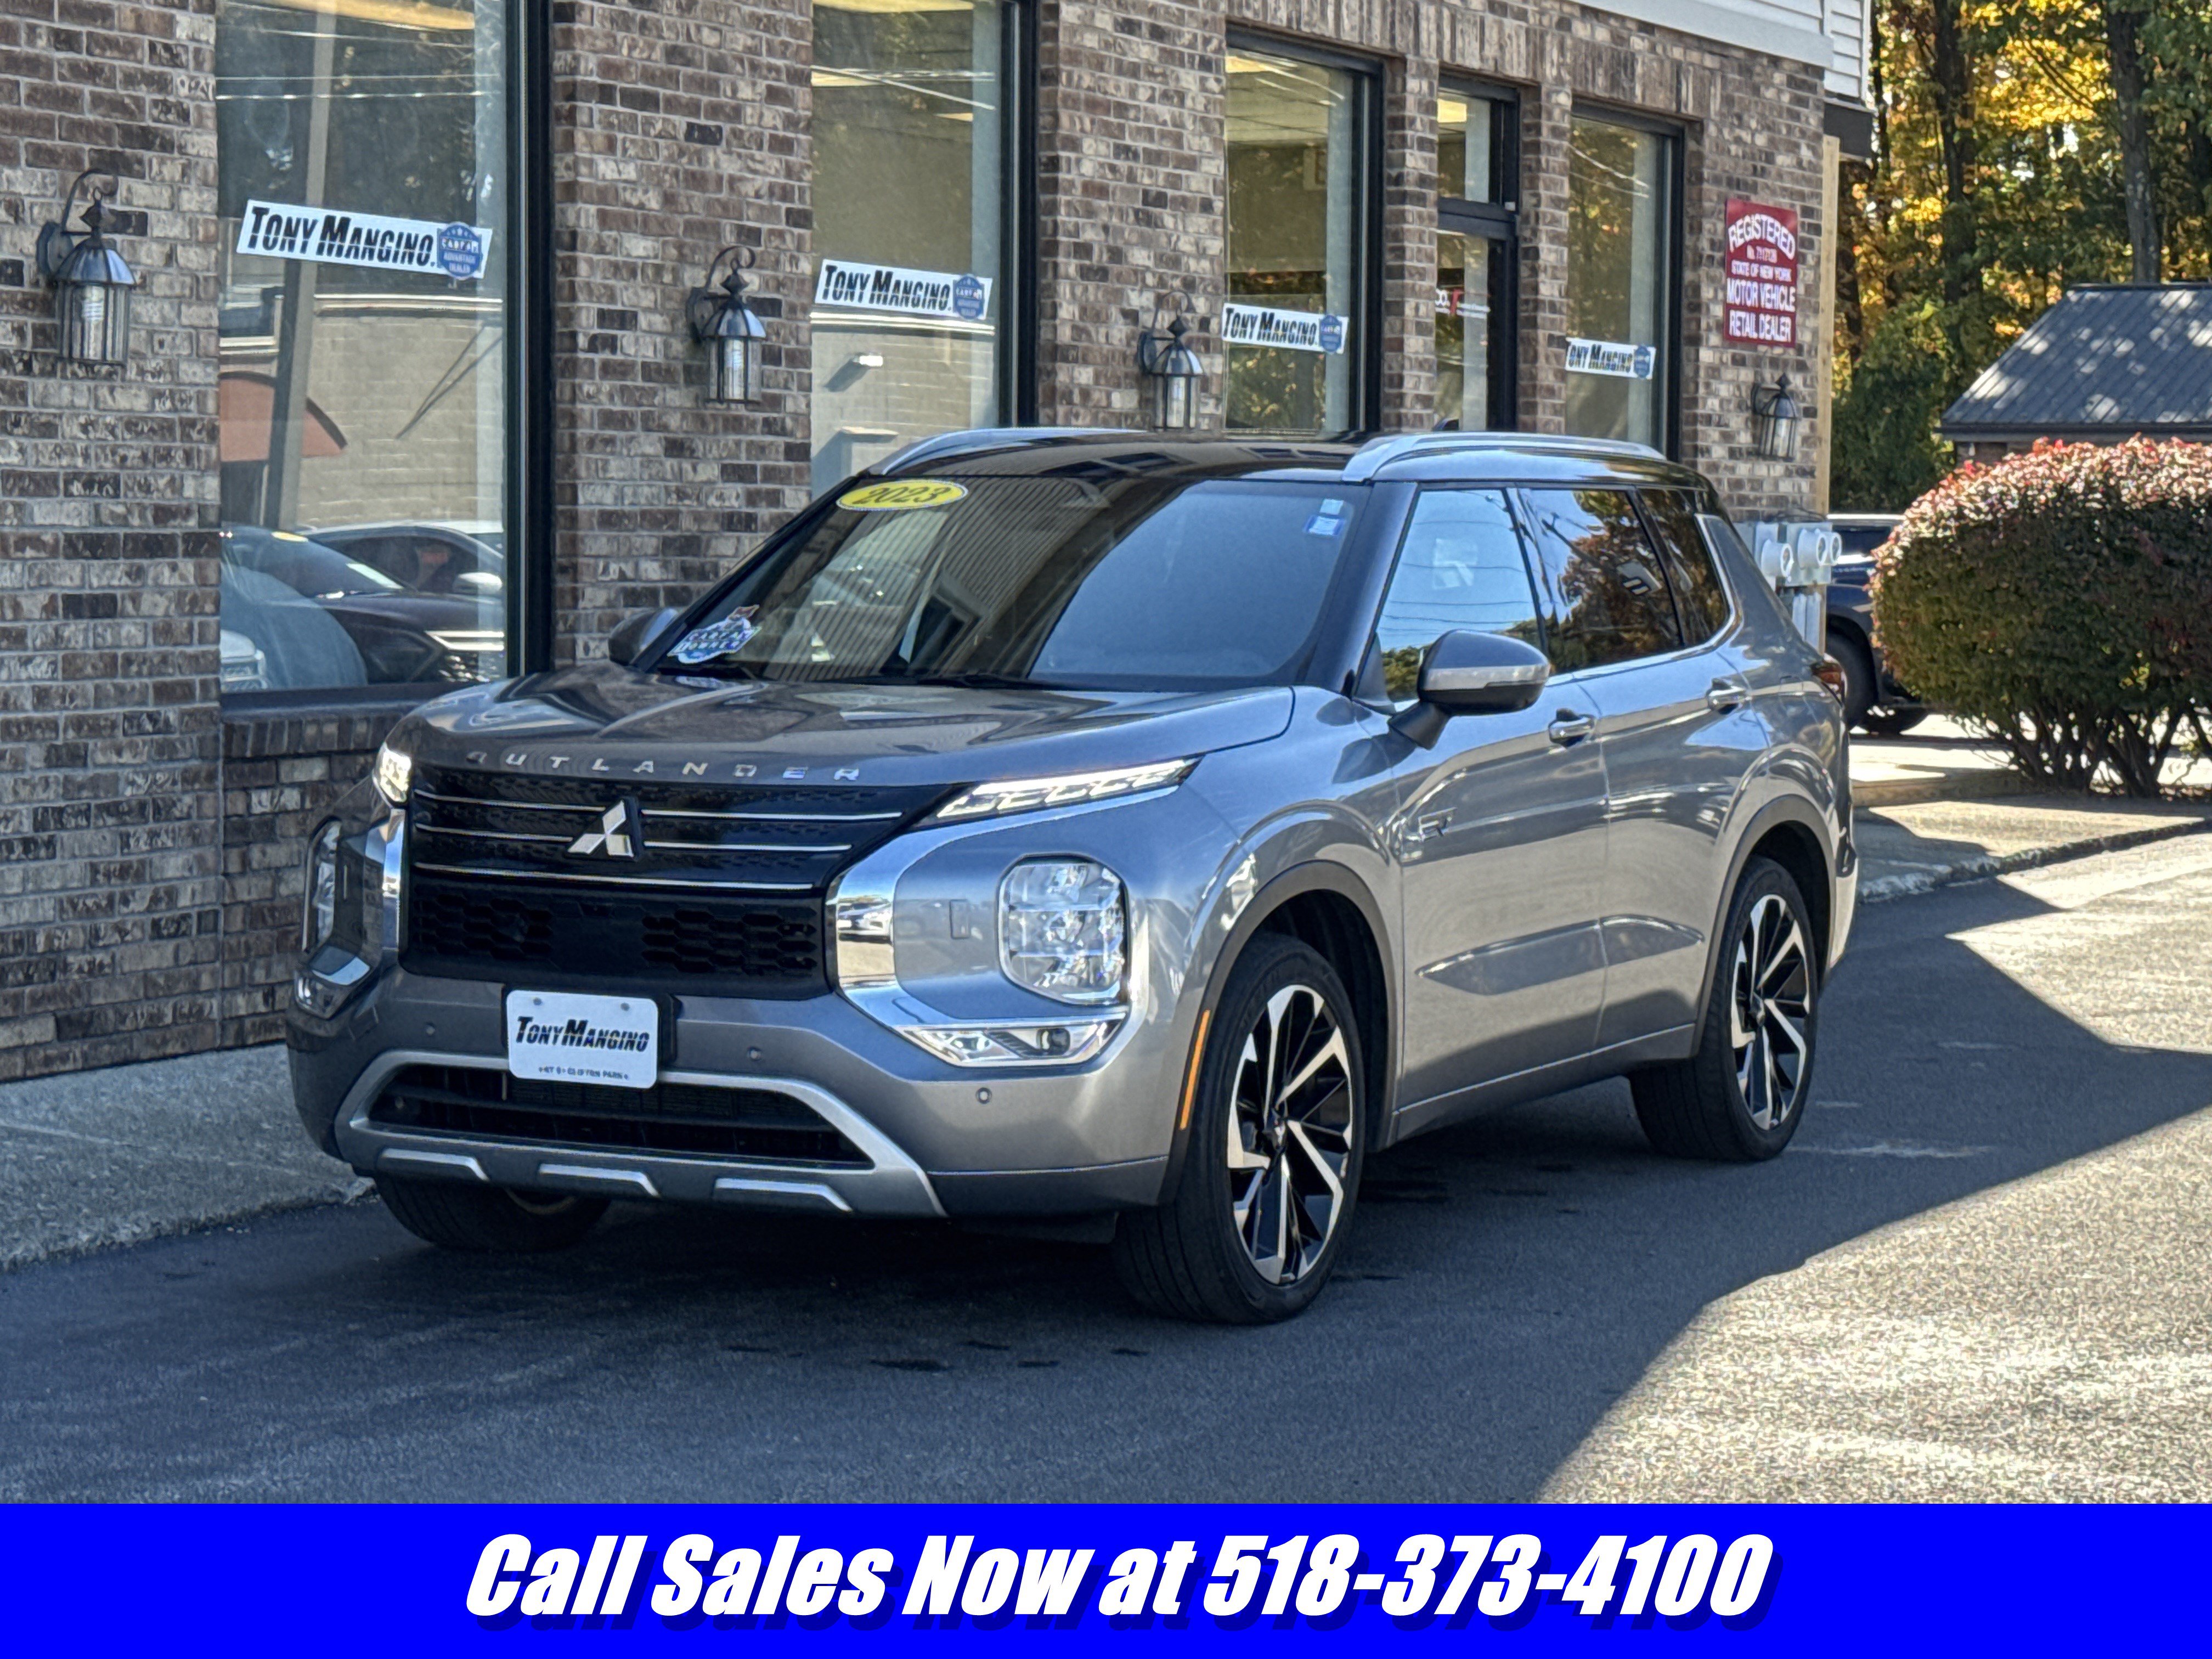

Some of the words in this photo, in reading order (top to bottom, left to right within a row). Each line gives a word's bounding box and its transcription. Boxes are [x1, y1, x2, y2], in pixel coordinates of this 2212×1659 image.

[247, 206, 319, 254] TONY
[1728, 213, 1796, 260] REGISTERED
[822, 264, 871, 303] TONY
[1726, 278, 1758, 308] MOTOR
[1759, 283, 1796, 312] VEHICLE
[1223, 307, 1259, 340] TONY
[1729, 309, 1757, 338] RETAIL
[1759, 313, 1792, 342] DEALER
[1567, 343, 1589, 368] ONY
[851, 486, 952, 505] 2023
[465, 750, 860, 781] OUTLANDER
